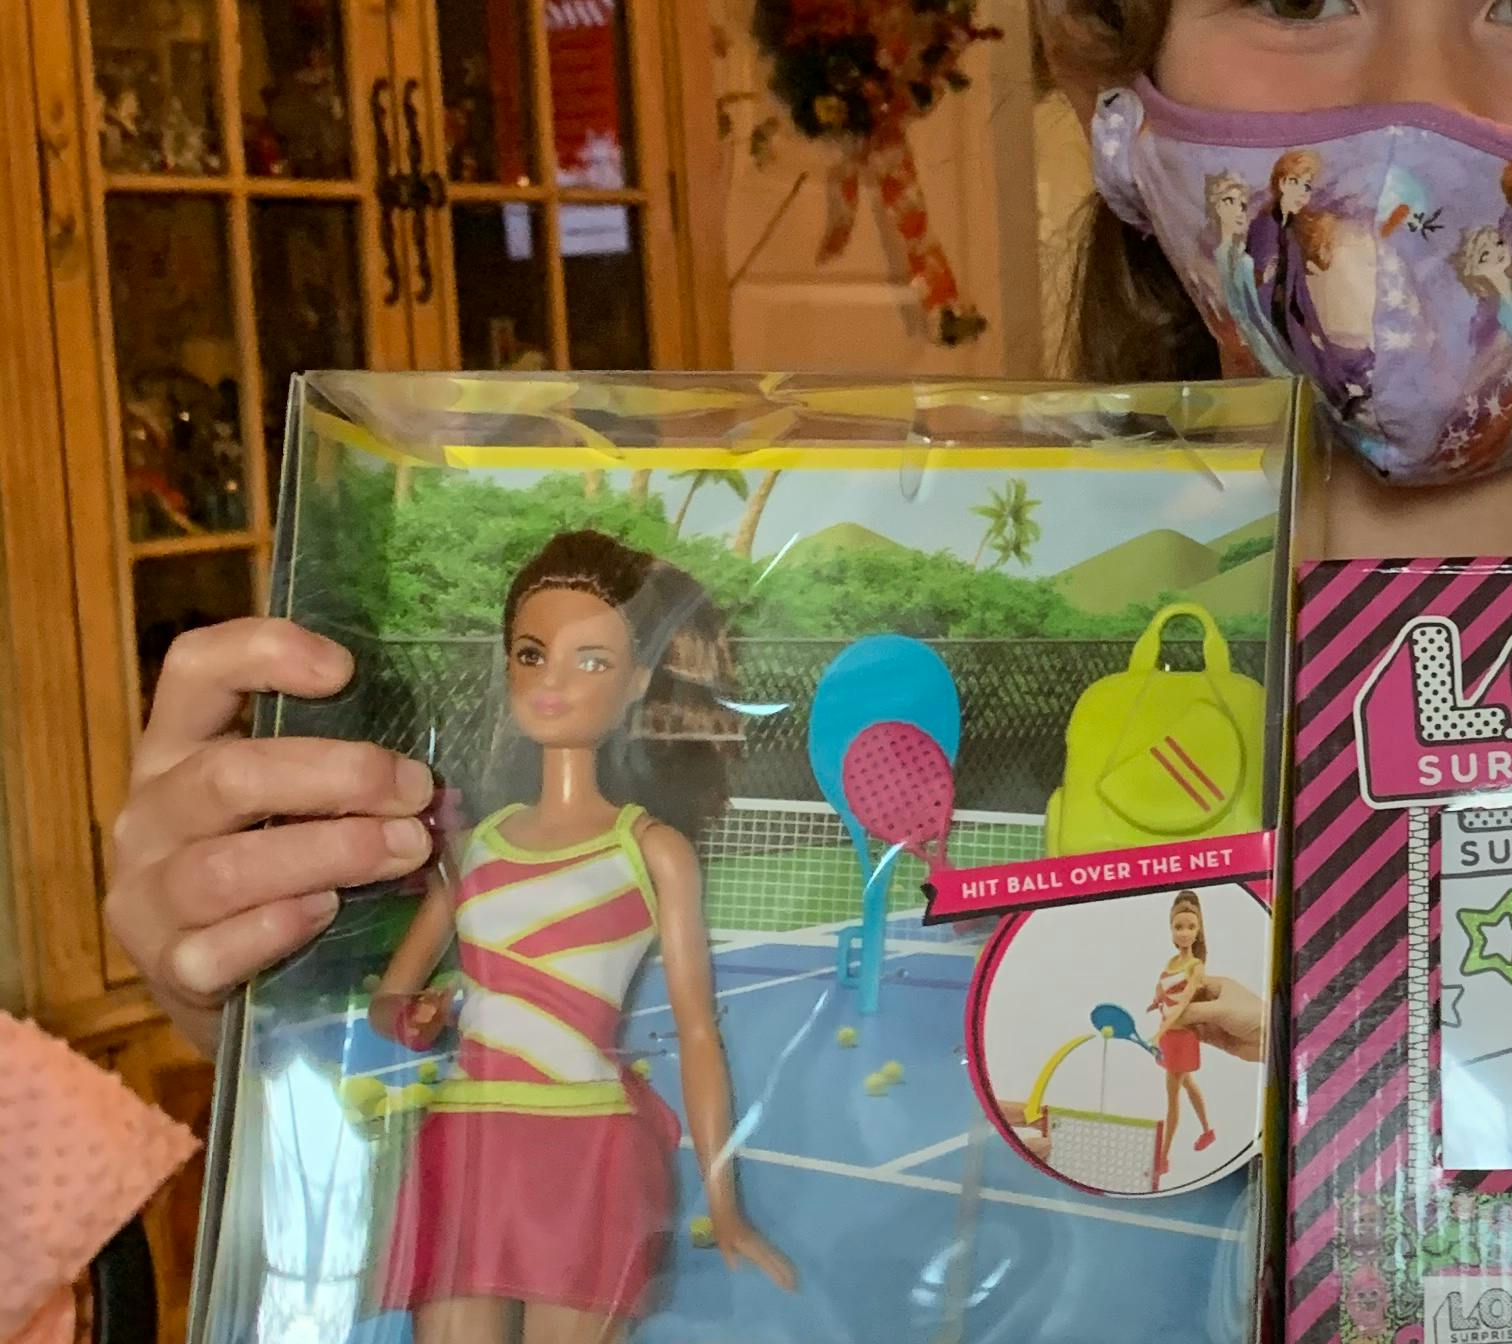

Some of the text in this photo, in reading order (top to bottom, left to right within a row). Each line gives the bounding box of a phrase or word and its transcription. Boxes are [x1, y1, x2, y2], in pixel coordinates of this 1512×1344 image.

[962, 849, 1234, 899] HIT BALL OVER THE NET
